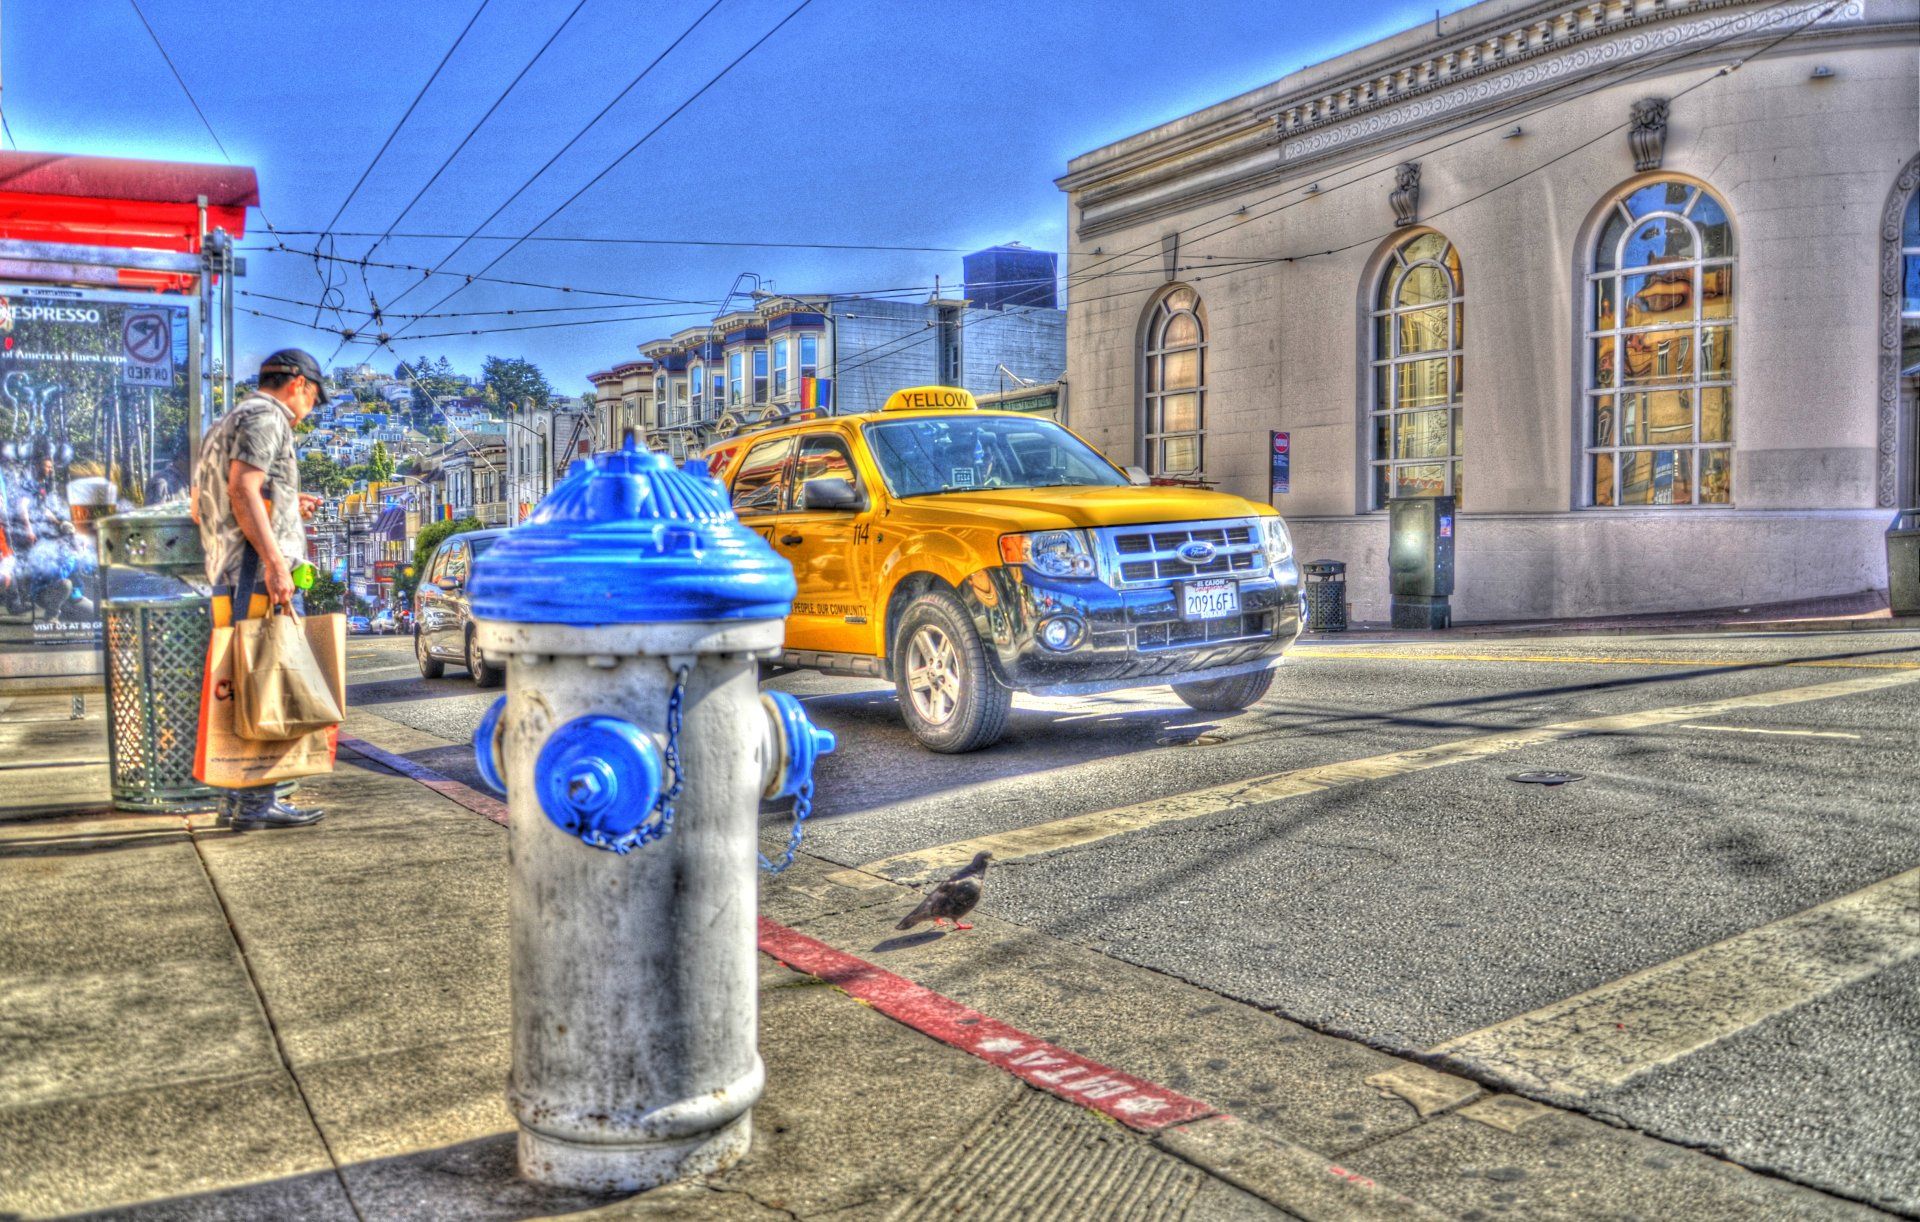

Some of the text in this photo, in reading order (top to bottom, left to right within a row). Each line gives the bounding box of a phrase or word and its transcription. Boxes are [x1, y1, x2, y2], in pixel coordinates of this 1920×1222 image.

[15, 349, 69, 361] America's
[71, 351, 101, 362] finest
[102, 354, 128, 366] cups
[901, 392, 968, 408] YELLOW
[853, 522, 869, 546] 114
[1205, 578, 1225, 586] CAJON
[816, 603, 828, 615] OUR
[1188, 592, 1237, 614] 20916F1
[34, 623, 54, 631] VISIT
[55, 622, 67, 630] US
[68, 622, 80, 630] AT
[1008, 1049, 1137, 1100] MTA
